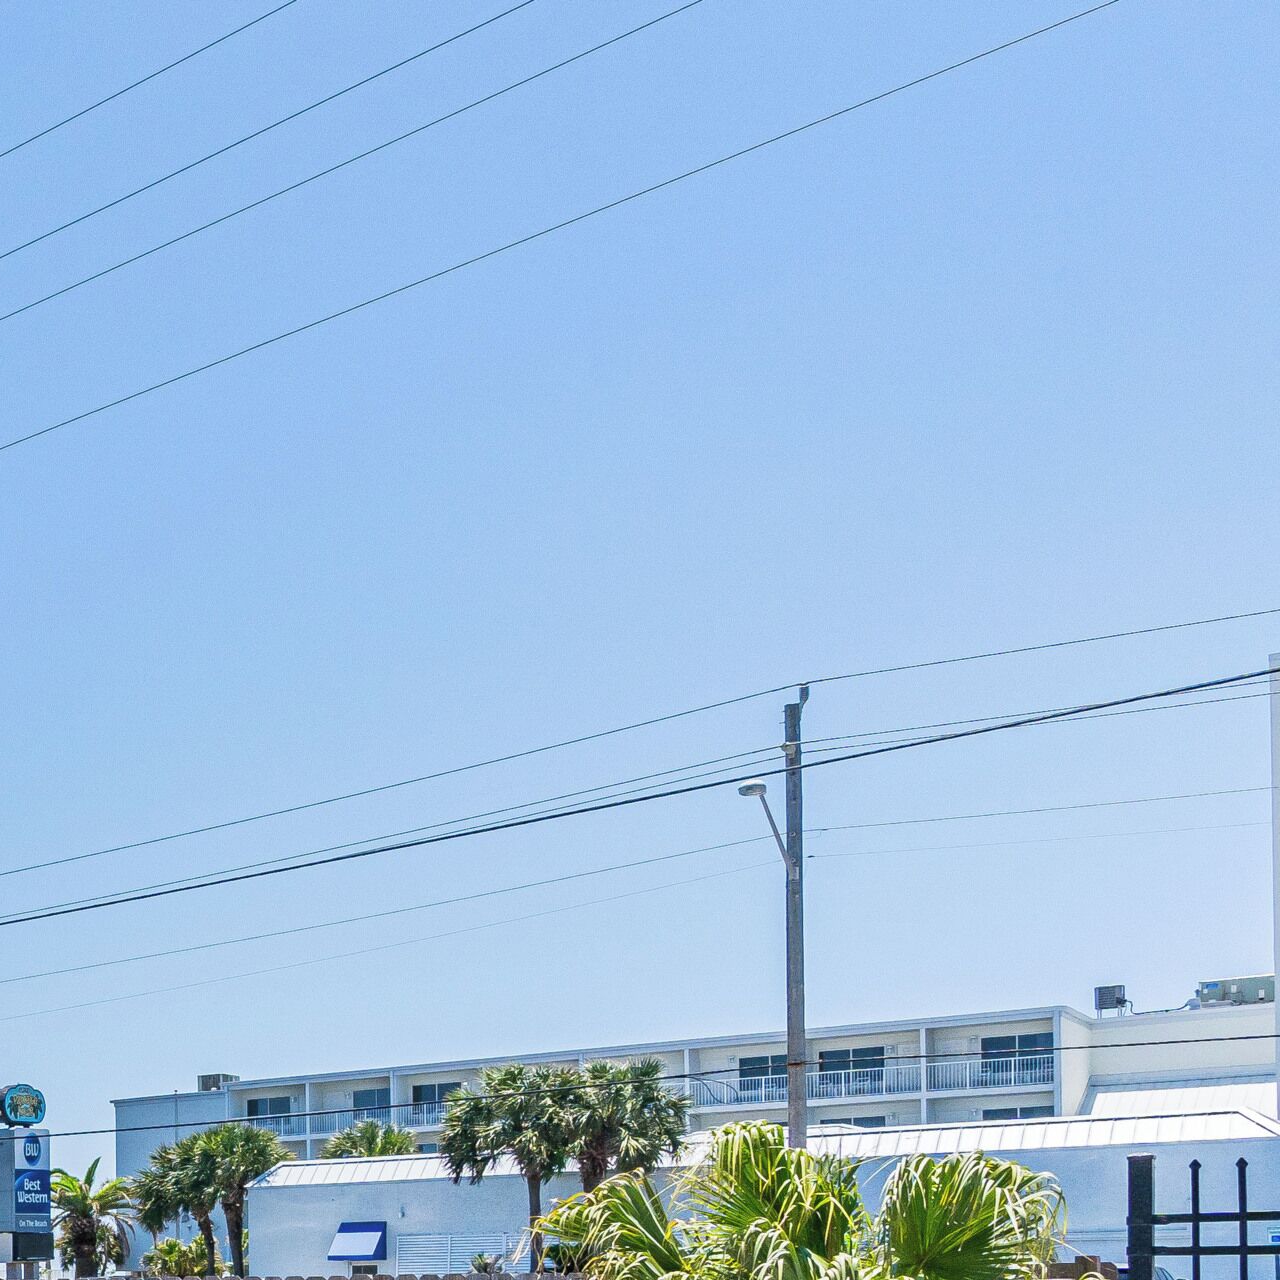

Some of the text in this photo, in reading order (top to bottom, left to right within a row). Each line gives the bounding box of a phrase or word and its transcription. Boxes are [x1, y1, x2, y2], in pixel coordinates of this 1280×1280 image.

[25, 1142, 40, 1157] BW
[23, 1178, 41, 1191] Best
[17, 1190, 48, 1204] Western
[18, 1219, 48, 1227] On The Beach
